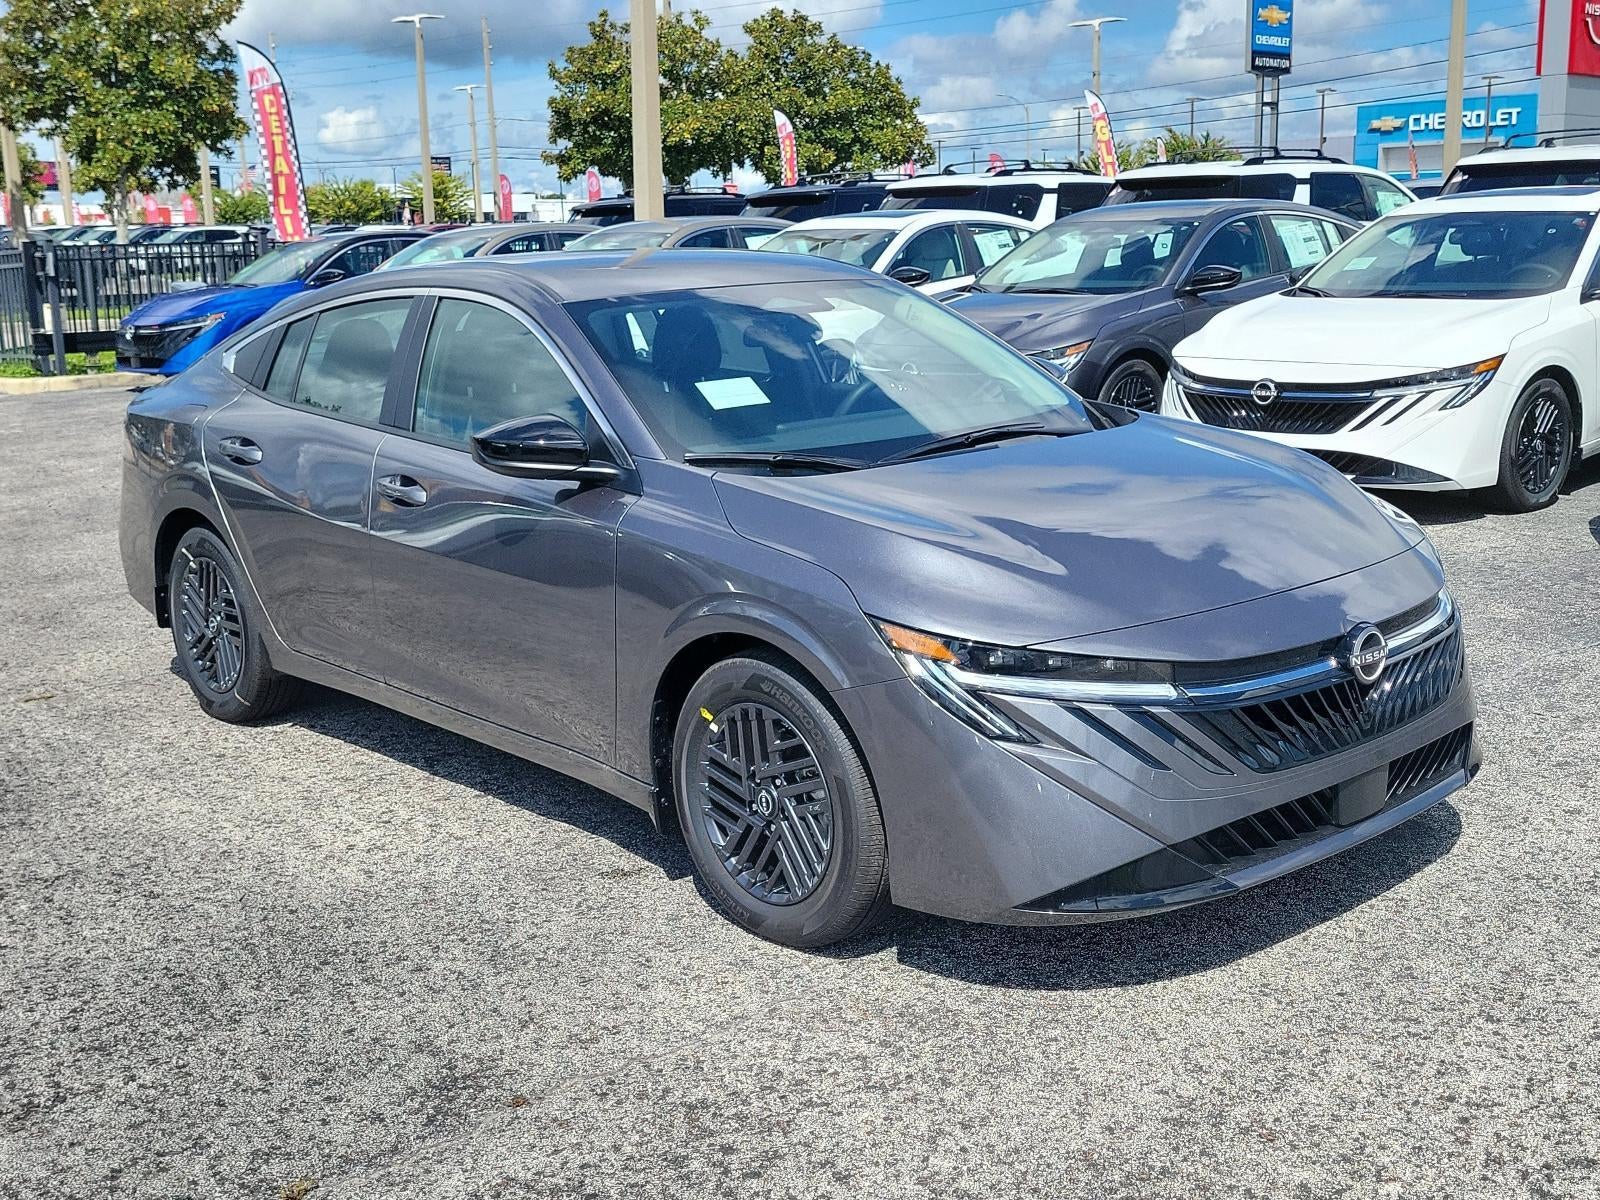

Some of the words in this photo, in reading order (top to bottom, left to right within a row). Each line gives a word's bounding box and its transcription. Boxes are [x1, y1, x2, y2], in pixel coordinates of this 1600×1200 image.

[1255, 34, 1291, 47] CHEVROLET
[1254, 56, 1290, 68] AUTONATION
[1408, 107, 1522, 131] CHEROLET
[263, 94, 300, 241] DETAILI
[1352, 646, 1389, 666] NISSAN
